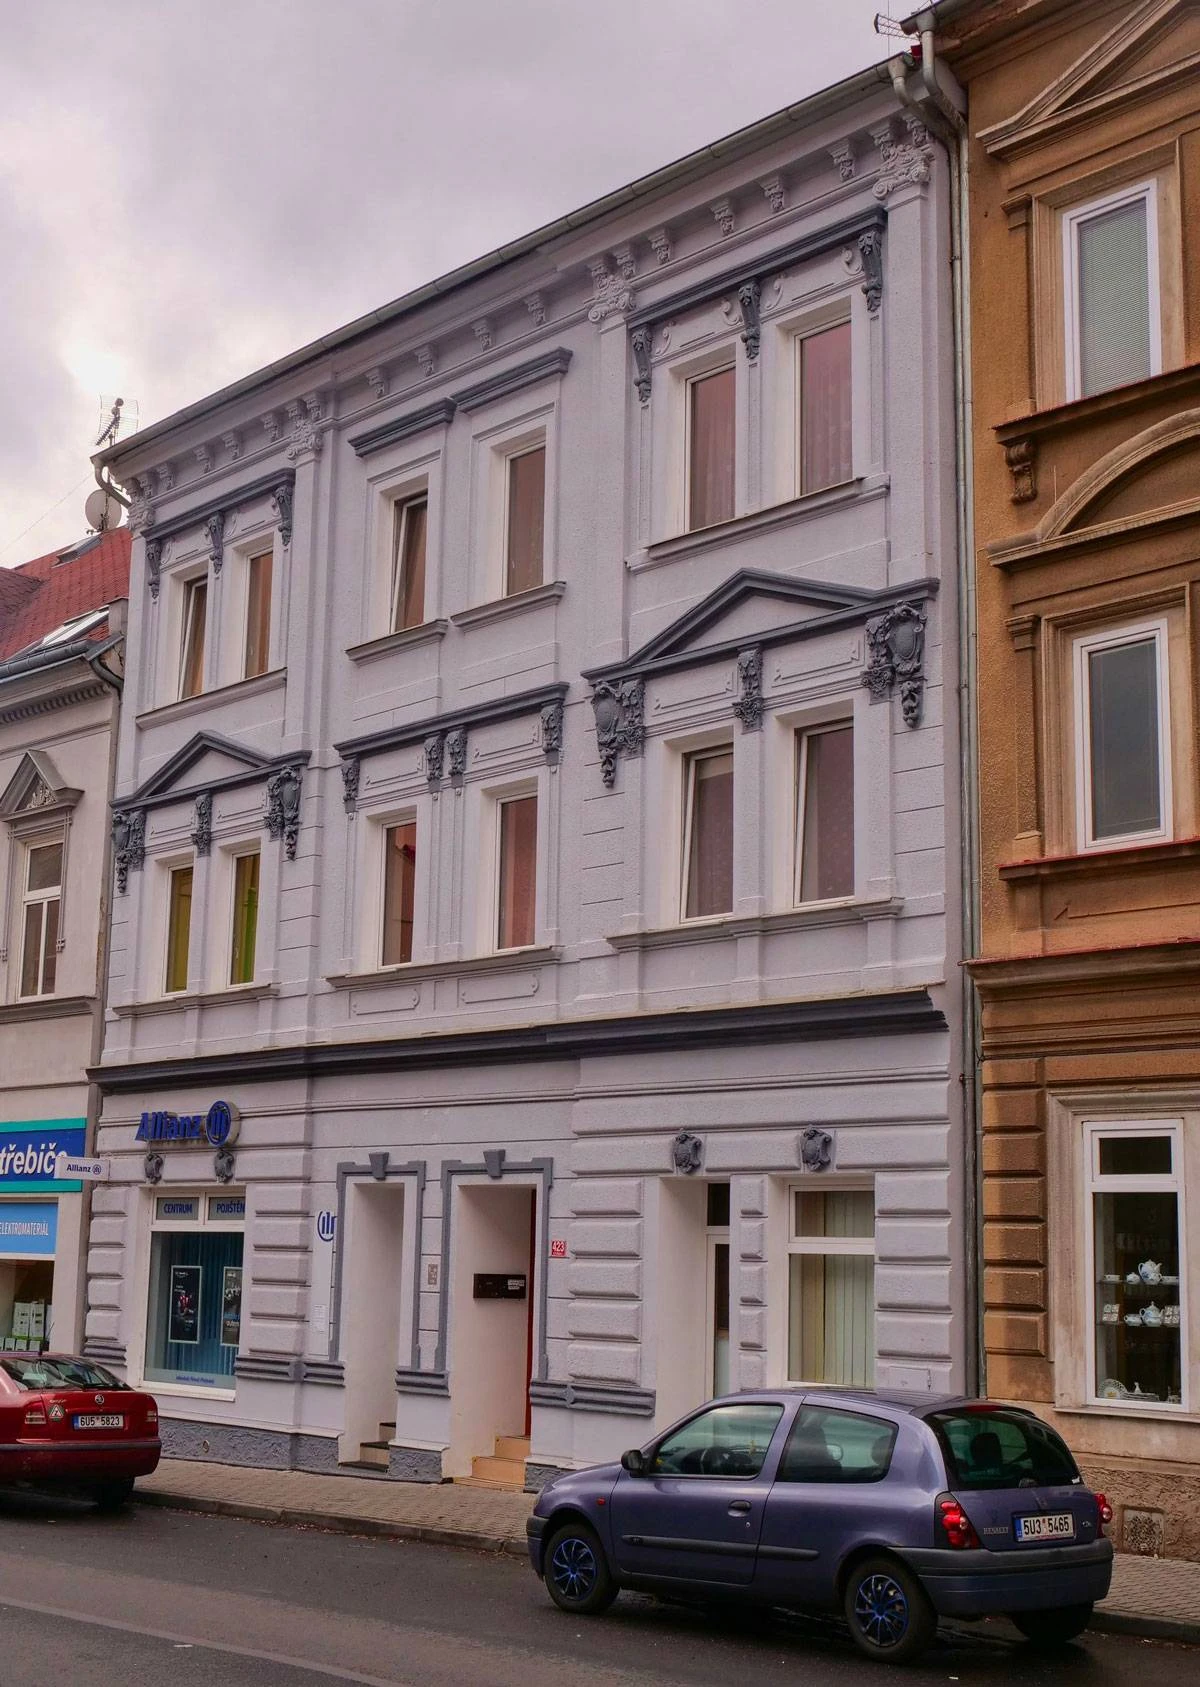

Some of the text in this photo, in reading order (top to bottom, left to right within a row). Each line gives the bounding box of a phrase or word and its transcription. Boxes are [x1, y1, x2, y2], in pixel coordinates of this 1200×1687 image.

[135, 1111, 202, 1142] Allianz
[0, 1142, 68, 1175] třebič
[66, 1163, 91, 1173] Allianz
[163, 1203, 193, 1214] CENTRUM
[552, 1241, 565, 1252] 423
[80, 1416, 120, 1427] 6U5 5823
[1023, 1519, 1042, 1536] 5U3
[1047, 1516, 1070, 1533] 5465
